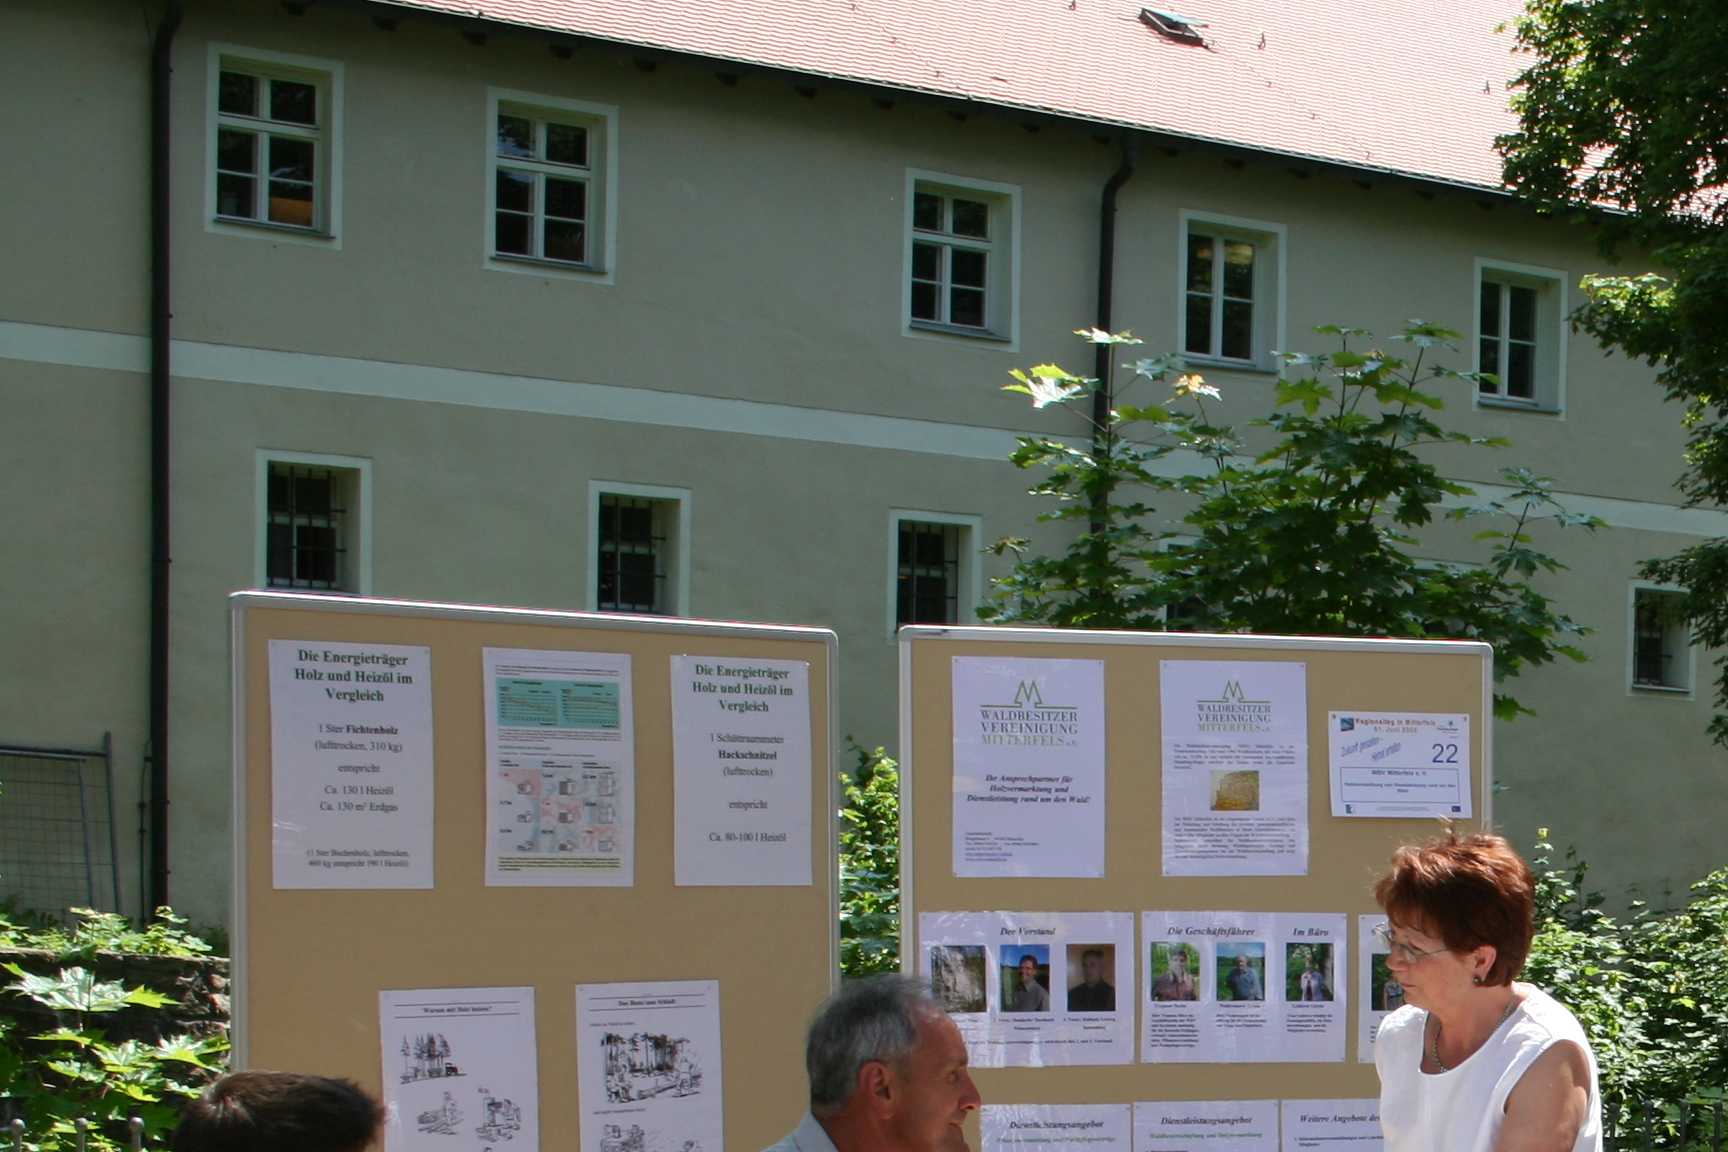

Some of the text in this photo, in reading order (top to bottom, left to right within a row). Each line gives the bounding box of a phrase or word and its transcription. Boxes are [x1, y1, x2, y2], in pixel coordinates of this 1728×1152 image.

[298, 649, 408, 667] Die Energieträger
[294, 668, 413, 684] Holz und Heizöl im
[695, 664, 790, 680] Die Energieträger
[692, 681, 793, 696] Holz und Heizöl im
[325, 688, 384, 703] Vergleich
[718, 699, 769, 713] Vergleich
[1197, 703, 1271, 713] WALDBESITZER
[980, 709, 1078, 722] WALDBESITZER
[1198, 713, 1271, 723] VEREINIGUNG
[326, 724, 344, 734] Ster
[346, 724, 399, 735] Fichtenholz
[980, 722, 1078, 735] VEREINIGUNG
[1198, 723, 1261, 733] MITTERFELS
[982, 734, 1065, 746] MITTERFELS
[718, 750, 777, 760] Hackschnitzel
[1432, 743, 1458, 763] 22
[338, 764, 381, 774] entspricht
[985, 774, 1073, 784] Ihr Ansprechpartner für
[324, 785, 338, 795] Ca.
[366, 786, 394, 795] Heizöl
[990, 785, 1052, 794] Holzvermarktung
[967, 795, 1019, 804] Dienstleistung
[320, 801, 334, 811] Ca.
[369, 802, 399, 813] Erdgas
[728, 800, 768, 811] entspricht
[761, 832, 786, 842] Heizöl
[1000, 927, 1056, 936] Der Vorstand
[1168, 926, 1256, 937] Die Geschäftsführer
[1293, 927, 1329, 936] Im Büro
[1160, 1116, 1252, 1126] Dienstleistungsangebot
[1300, 1114, 1329, 1122] Weitere
[1333, 1114, 1366, 1123] Angebote
